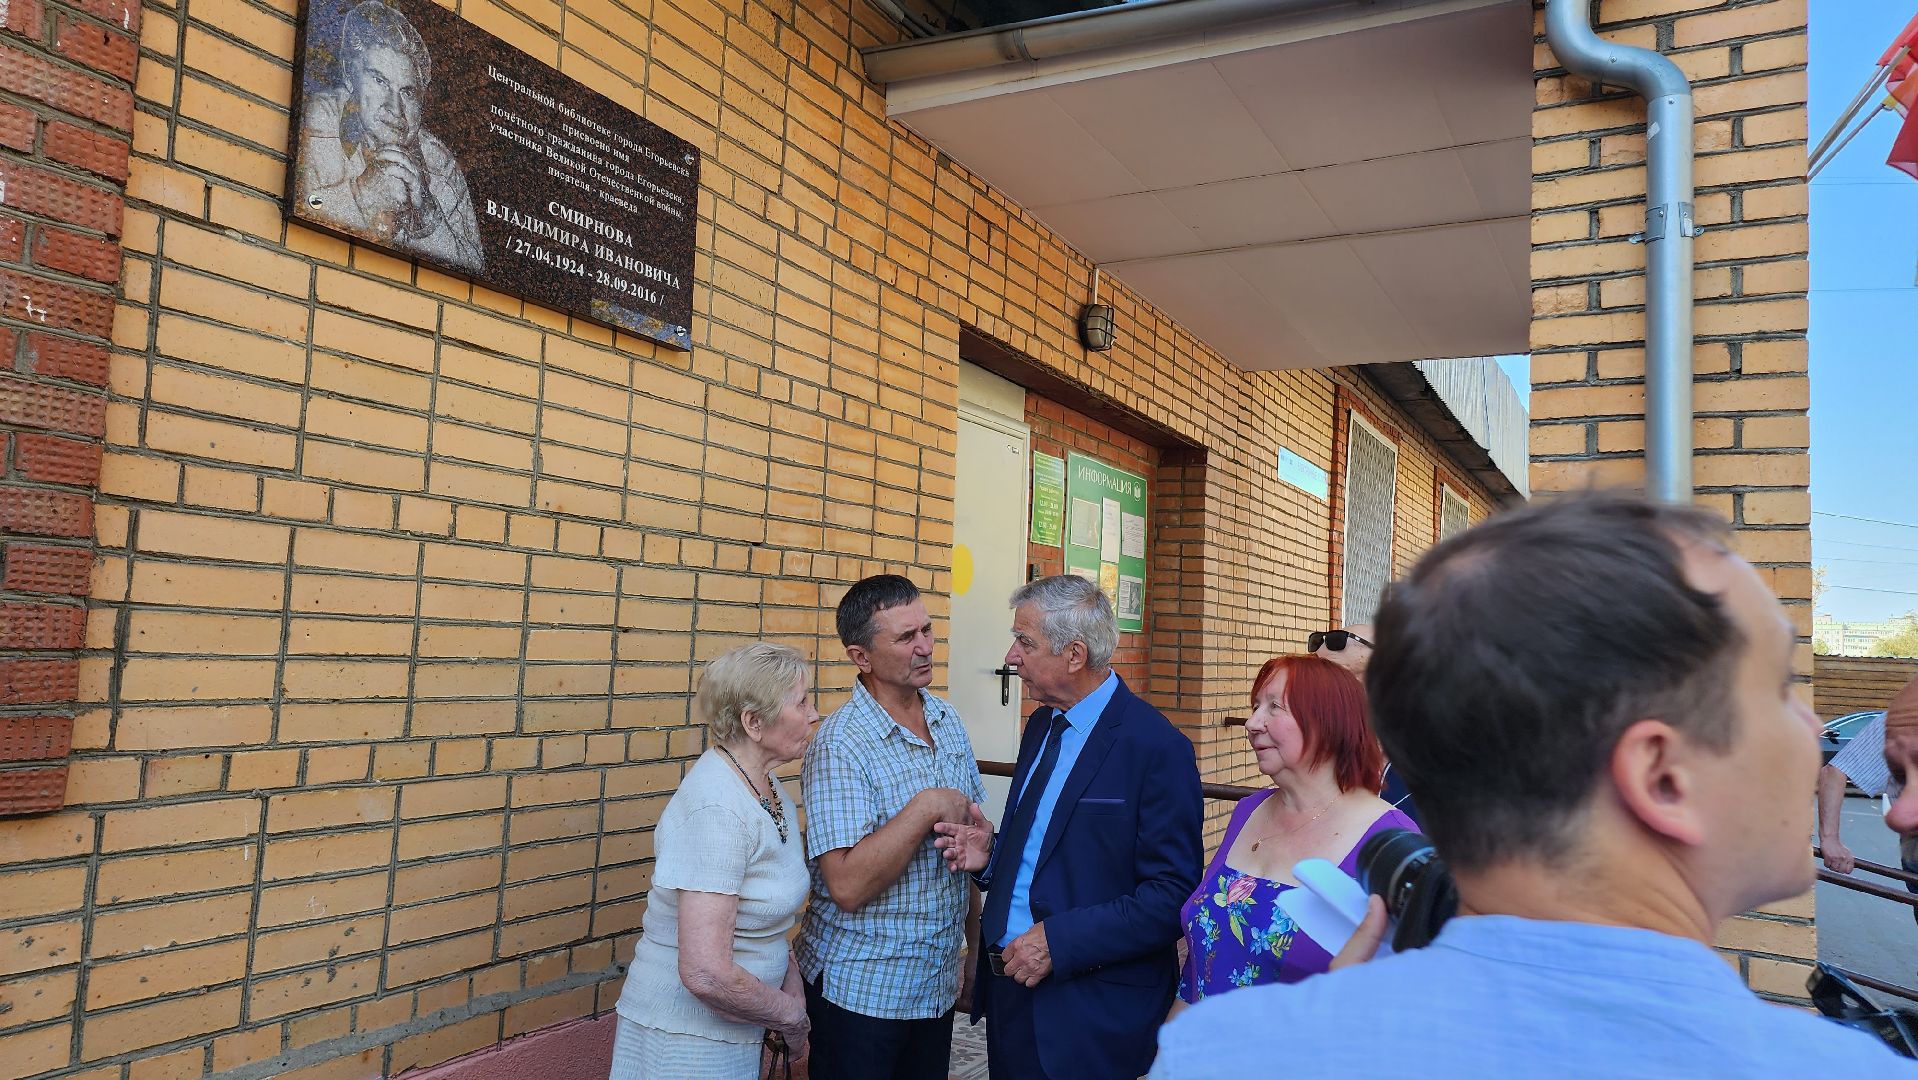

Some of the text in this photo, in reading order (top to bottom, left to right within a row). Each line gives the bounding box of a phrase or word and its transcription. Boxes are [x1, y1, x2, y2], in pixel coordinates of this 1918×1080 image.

[488, 64, 690, 178] Центральной библиотеке города Егорьевска
[491, 104, 545, 137] почётного
[547, 132, 603, 165] гражданина
[605, 161, 635, 181] города
[562, 123, 630, 163] присвоено имя
[490, 122, 542, 153] участника
[546, 145, 587, 174] Великой
[589, 167, 655, 206] Отечественной
[548, 166, 591, 192] писателя
[599, 190, 638, 214] краеведа
[486, 198, 680, 290] ВЛАДИМИРА ИВАНОВИЧА
[548, 201, 633, 248] СМИРНОВА
[514, 239, 585, 277] 27.04.1924
[596, 269, 657, 304] 28.09.2016
[1078, 464, 1132, 496] ИНФОРМАЦИЯ
